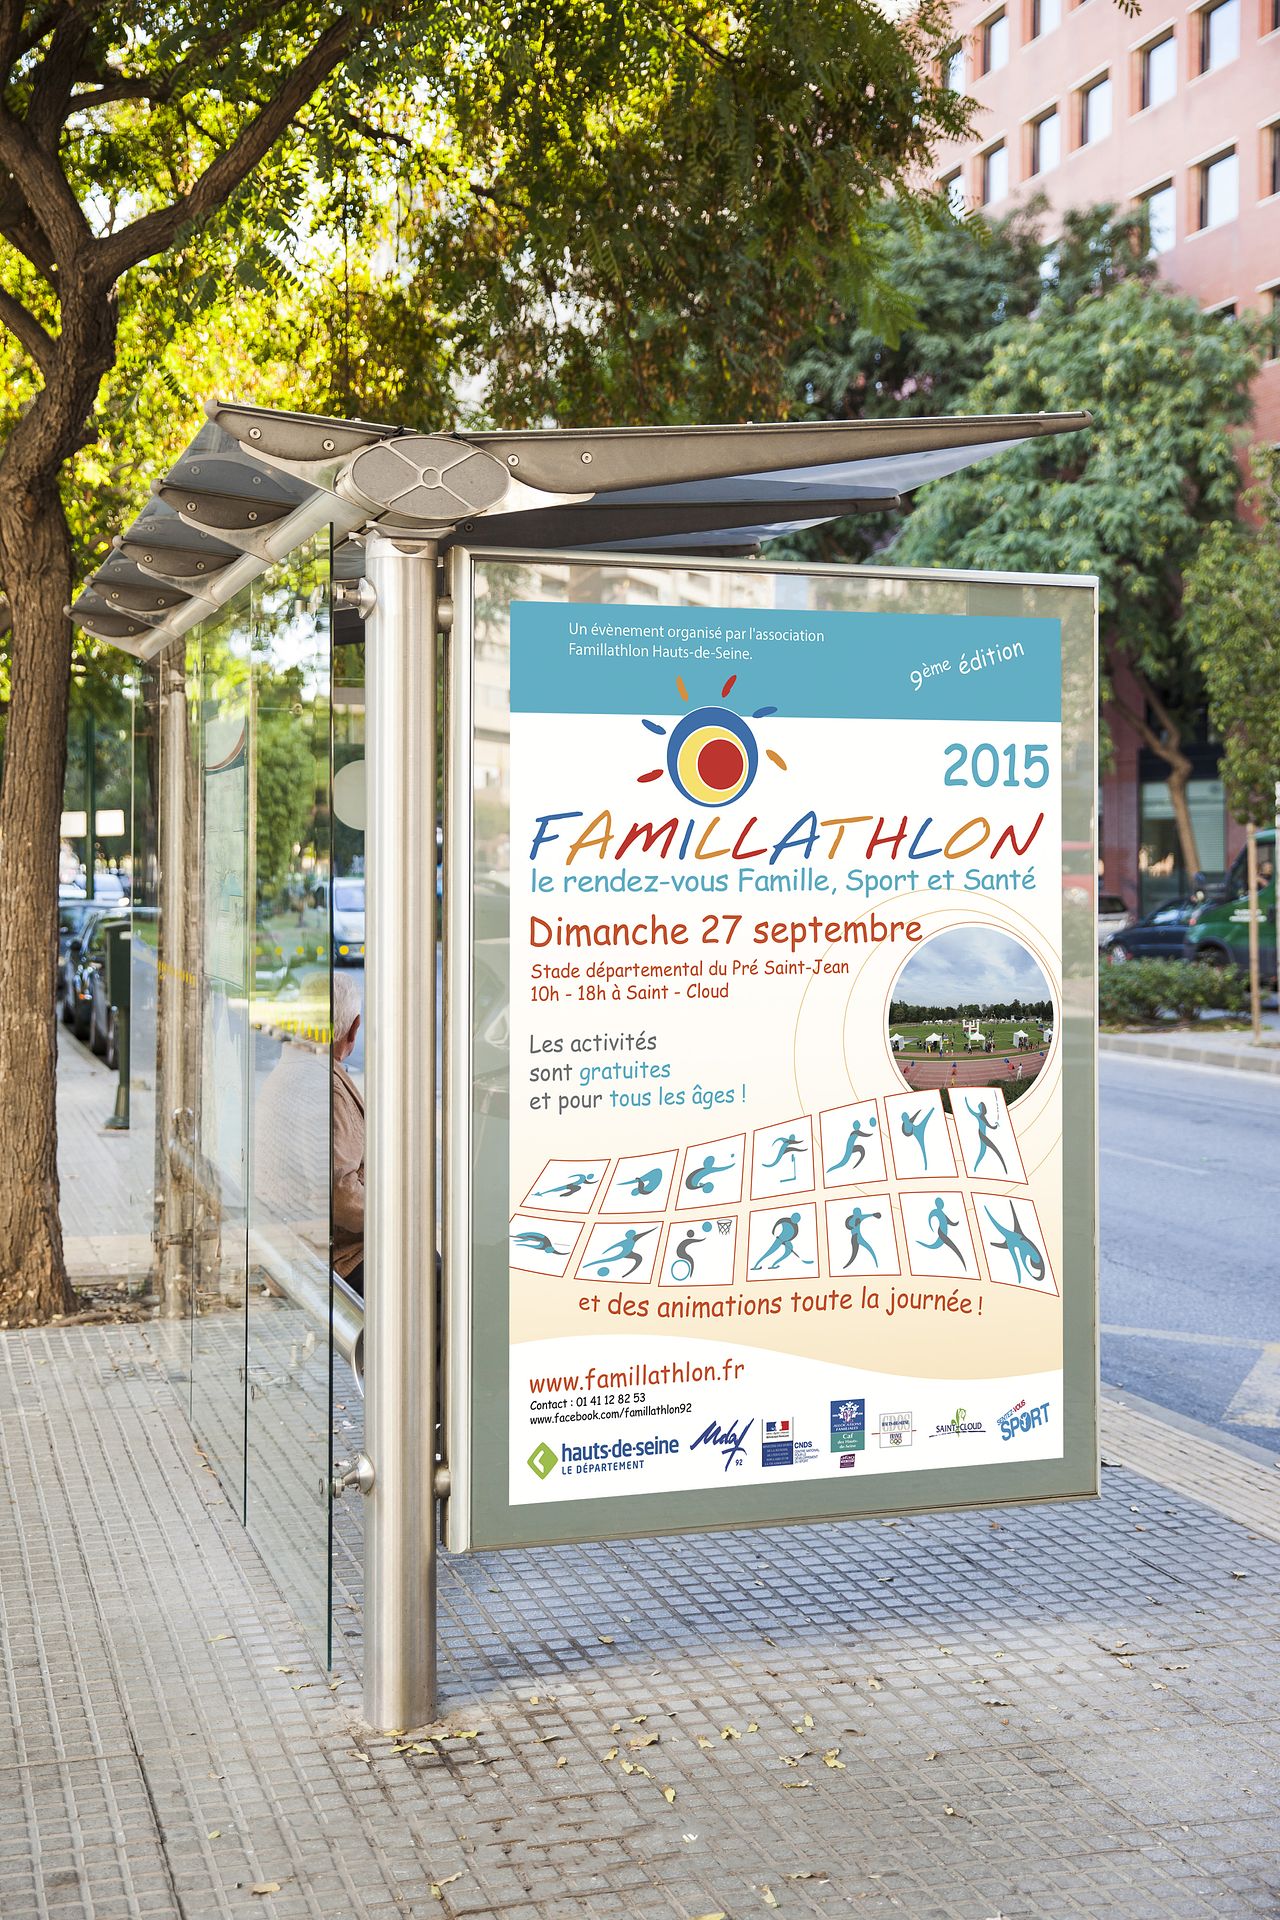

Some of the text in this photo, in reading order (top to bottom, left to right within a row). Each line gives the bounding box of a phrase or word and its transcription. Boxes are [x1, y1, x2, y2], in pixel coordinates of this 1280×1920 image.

[568, 623, 825, 642] Un évènement organisé par l'association
[568, 643, 753, 659] Famillathlon Hauts-de-Seine.
[910, 642, 1024, 691] 9ème édition
[943, 743, 1050, 789] 2015
[529, 809, 1044, 866] FAMILLATHLON
[530, 866, 1036, 899] le rendez-vous Famille, Sport et Santé
[529, 912, 924, 952] Dimanche 27 septembre
[530, 959, 850, 981] Stade départemental du Pré Saint-Jean
[530, 985, 560, 1002] 10h
[577, 984, 606, 1001] 18h
[611, 984, 622, 1001] à
[626, 984, 669, 1001] Saint
[687, 982, 729, 999] Cloud
[529, 1031, 657, 1054] Les activités
[529, 1060, 671, 1084] sont gratuites
[529, 1083, 747, 1115] et pour tous les âges !
[578, 1286, 983, 1319] et des animations toute la journée !
[530, 1358, 744, 1394] www.famillathlon.fr
[530, 1399, 567, 1411] Contact
[576, 1397, 587, 1407] 01
[590, 1396, 601, 1406] 41
[605, 1395, 615, 1405] 12
[618, 1394, 631, 1404] 82
[633, 1393, 646, 1403] 53
[530, 1403, 692, 1425] www.facebook.com/famillathlon92
[1001, 1402, 1049, 1441] SPORT
[562, 1460, 644, 1475] LE DÉPARTEMENT
